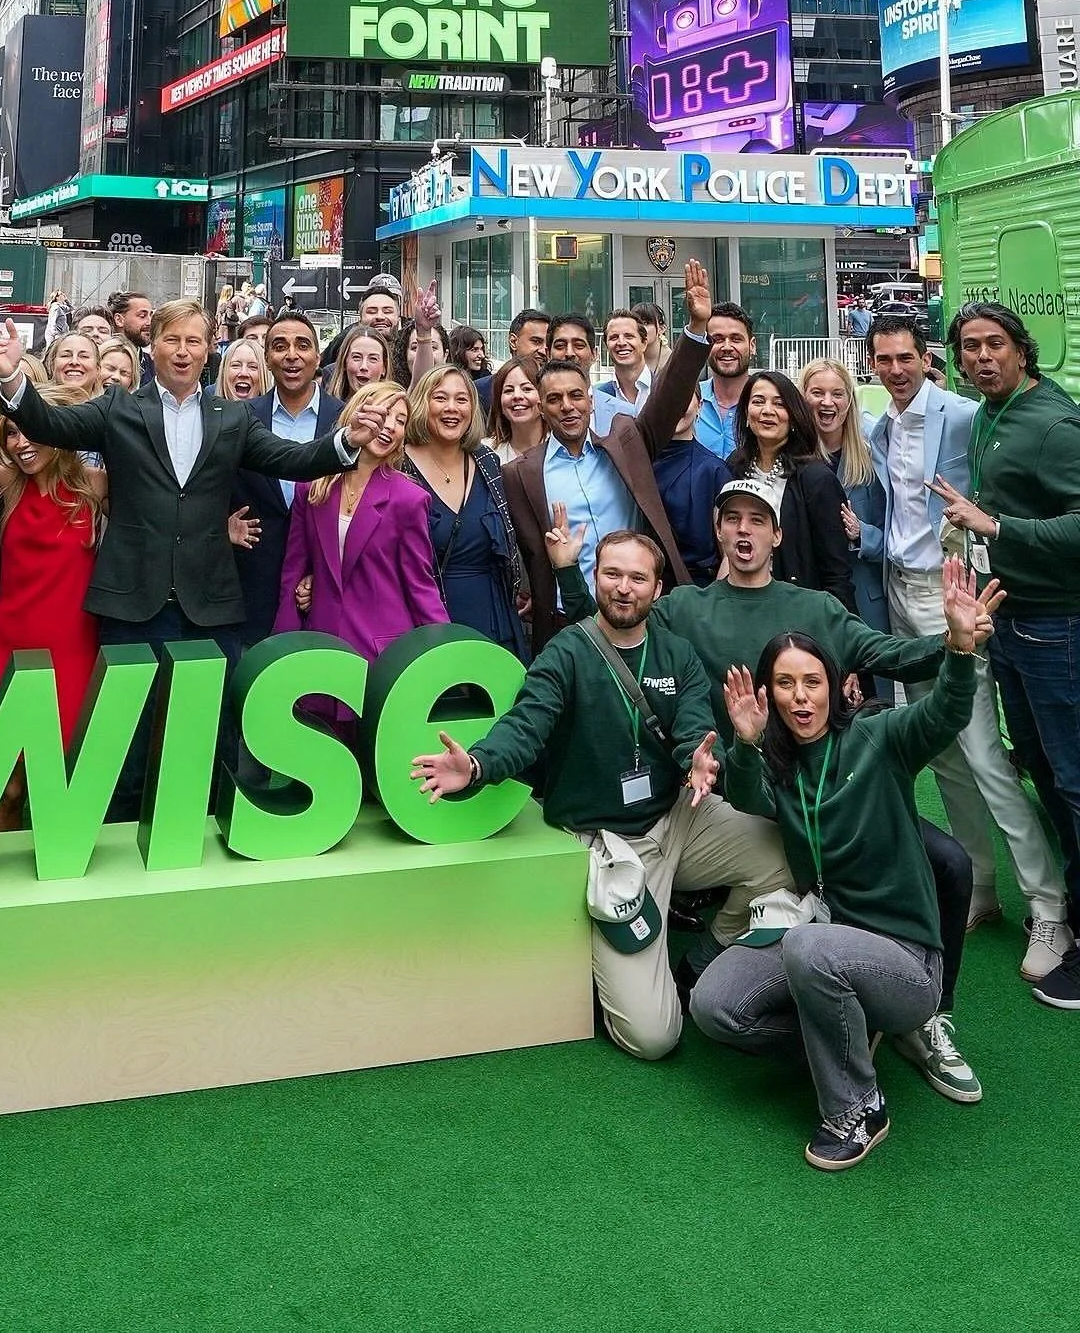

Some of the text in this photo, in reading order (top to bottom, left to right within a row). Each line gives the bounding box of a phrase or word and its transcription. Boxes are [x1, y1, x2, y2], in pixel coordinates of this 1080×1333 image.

[349, 5, 550, 62] FORINT
[948, 54, 982, 67] MorganChase
[1055, 18, 1078, 91] UARE
[31, 66, 58, 81] The
[170, 83, 185, 104] BEST
[185, 75, 203, 97] VIEWS
[203, 71, 212, 88] OF
[212, 59, 232, 84] TIMES
[232, 45, 260, 75] SQUARE
[407, 73, 505, 93] NEWTRADITION
[53, 84, 81, 99] face
[471, 148, 917, 208] NEW YORK POLICE DEPT
[299, 193, 317, 212] one
[296, 212, 324, 230] times
[111, 232, 142, 244] one
[296, 230, 331, 250] square
[752, 906, 766, 919] NY
